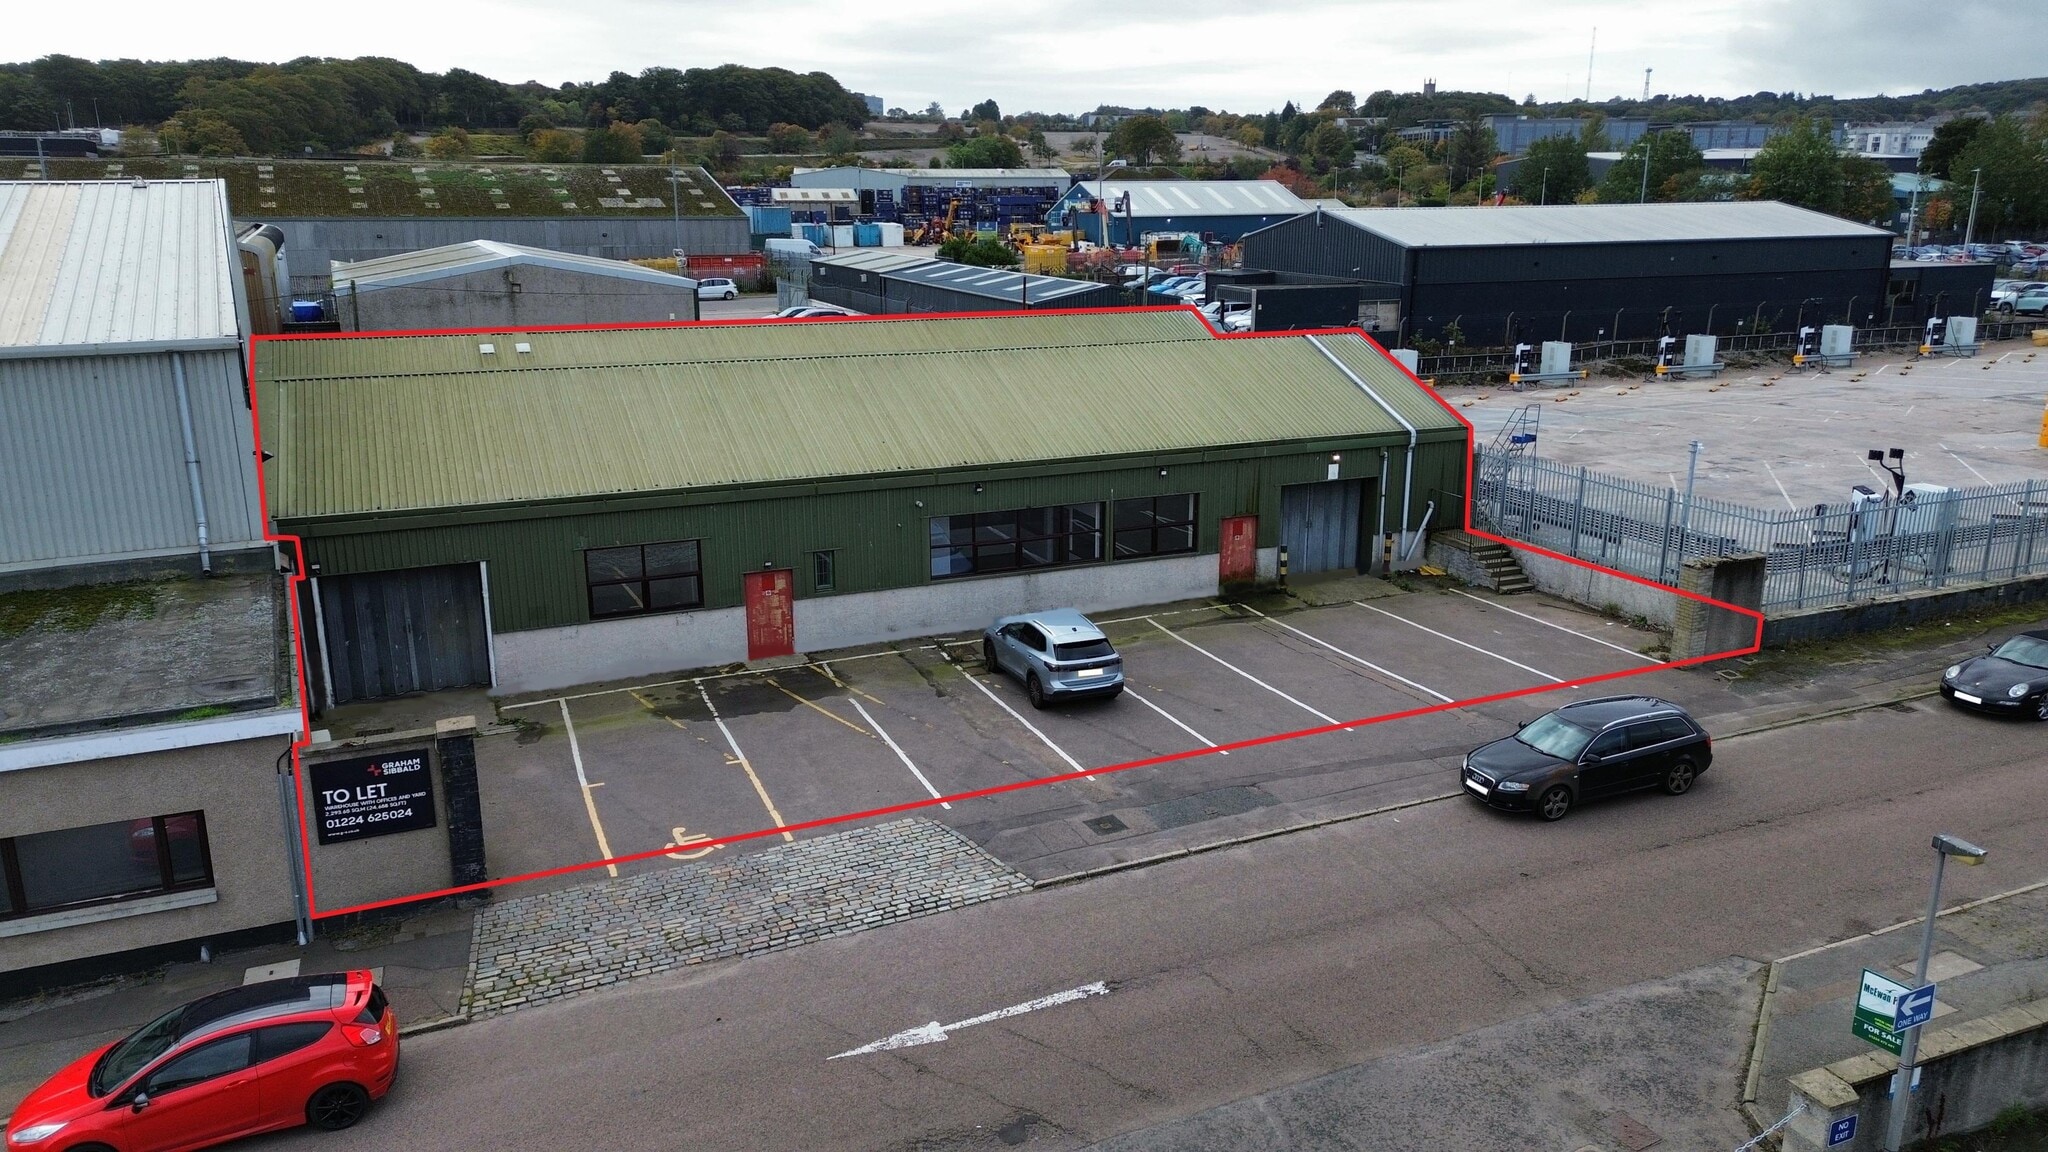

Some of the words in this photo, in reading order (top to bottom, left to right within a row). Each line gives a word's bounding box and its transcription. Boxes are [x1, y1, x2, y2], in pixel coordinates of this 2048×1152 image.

[382, 758, 420, 769] GRAHAM
[383, 764, 421, 775] SIBBALD
[322, 789, 350, 804] TO
[356, 783, 388, 800] LET
[324, 802, 359, 811] WAREHOUSE
[376, 796, 397, 804] OFFICES
[326, 815, 364, 829] 01224
[367, 808, 413, 823] 625024
[1863, 983, 1892, 1003] McEwan
[1897, 1017, 1912, 1028] ONE
[1913, 1012, 1928, 1023] WAY
[1863, 1023, 1880, 1035] FOR
[1881, 1032, 1902, 1046] SALE
[1838, 1121, 1849, 1131] NO
[1834, 1130, 1849, 1141] EXIT
